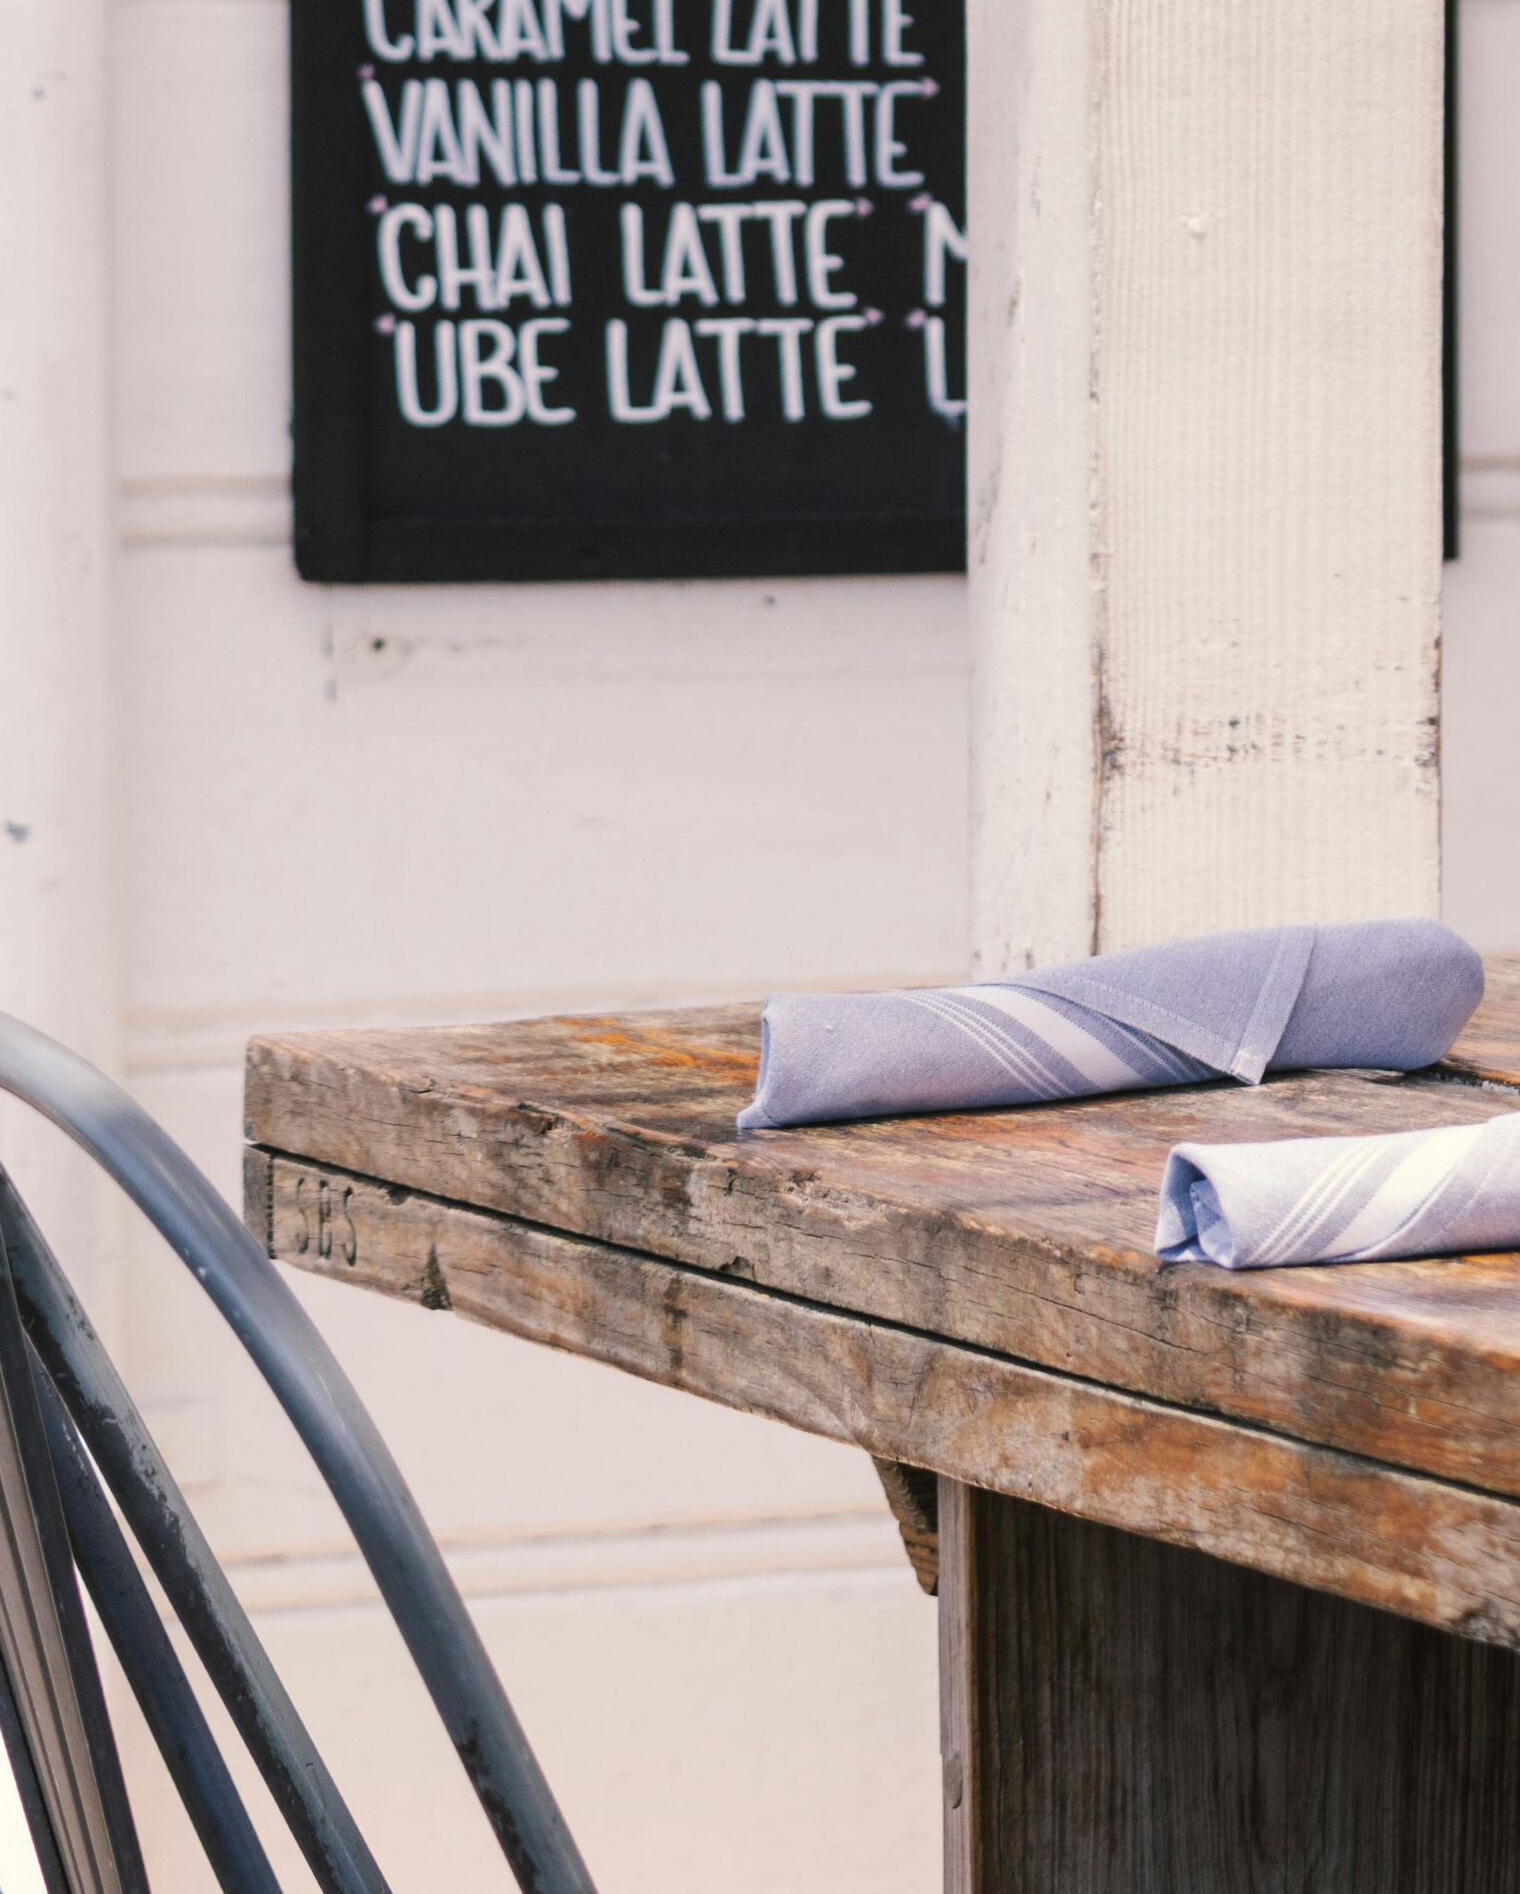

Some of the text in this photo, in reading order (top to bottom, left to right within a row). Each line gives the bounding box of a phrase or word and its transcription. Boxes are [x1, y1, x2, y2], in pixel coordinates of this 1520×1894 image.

[361, 77, 926, 189] VANILLA LATTE
[376, 202, 572, 312] CHAI
[620, 200, 857, 309] LATTE
[391, 318, 577, 428] UBE
[605, 317, 873, 424] LATTE
